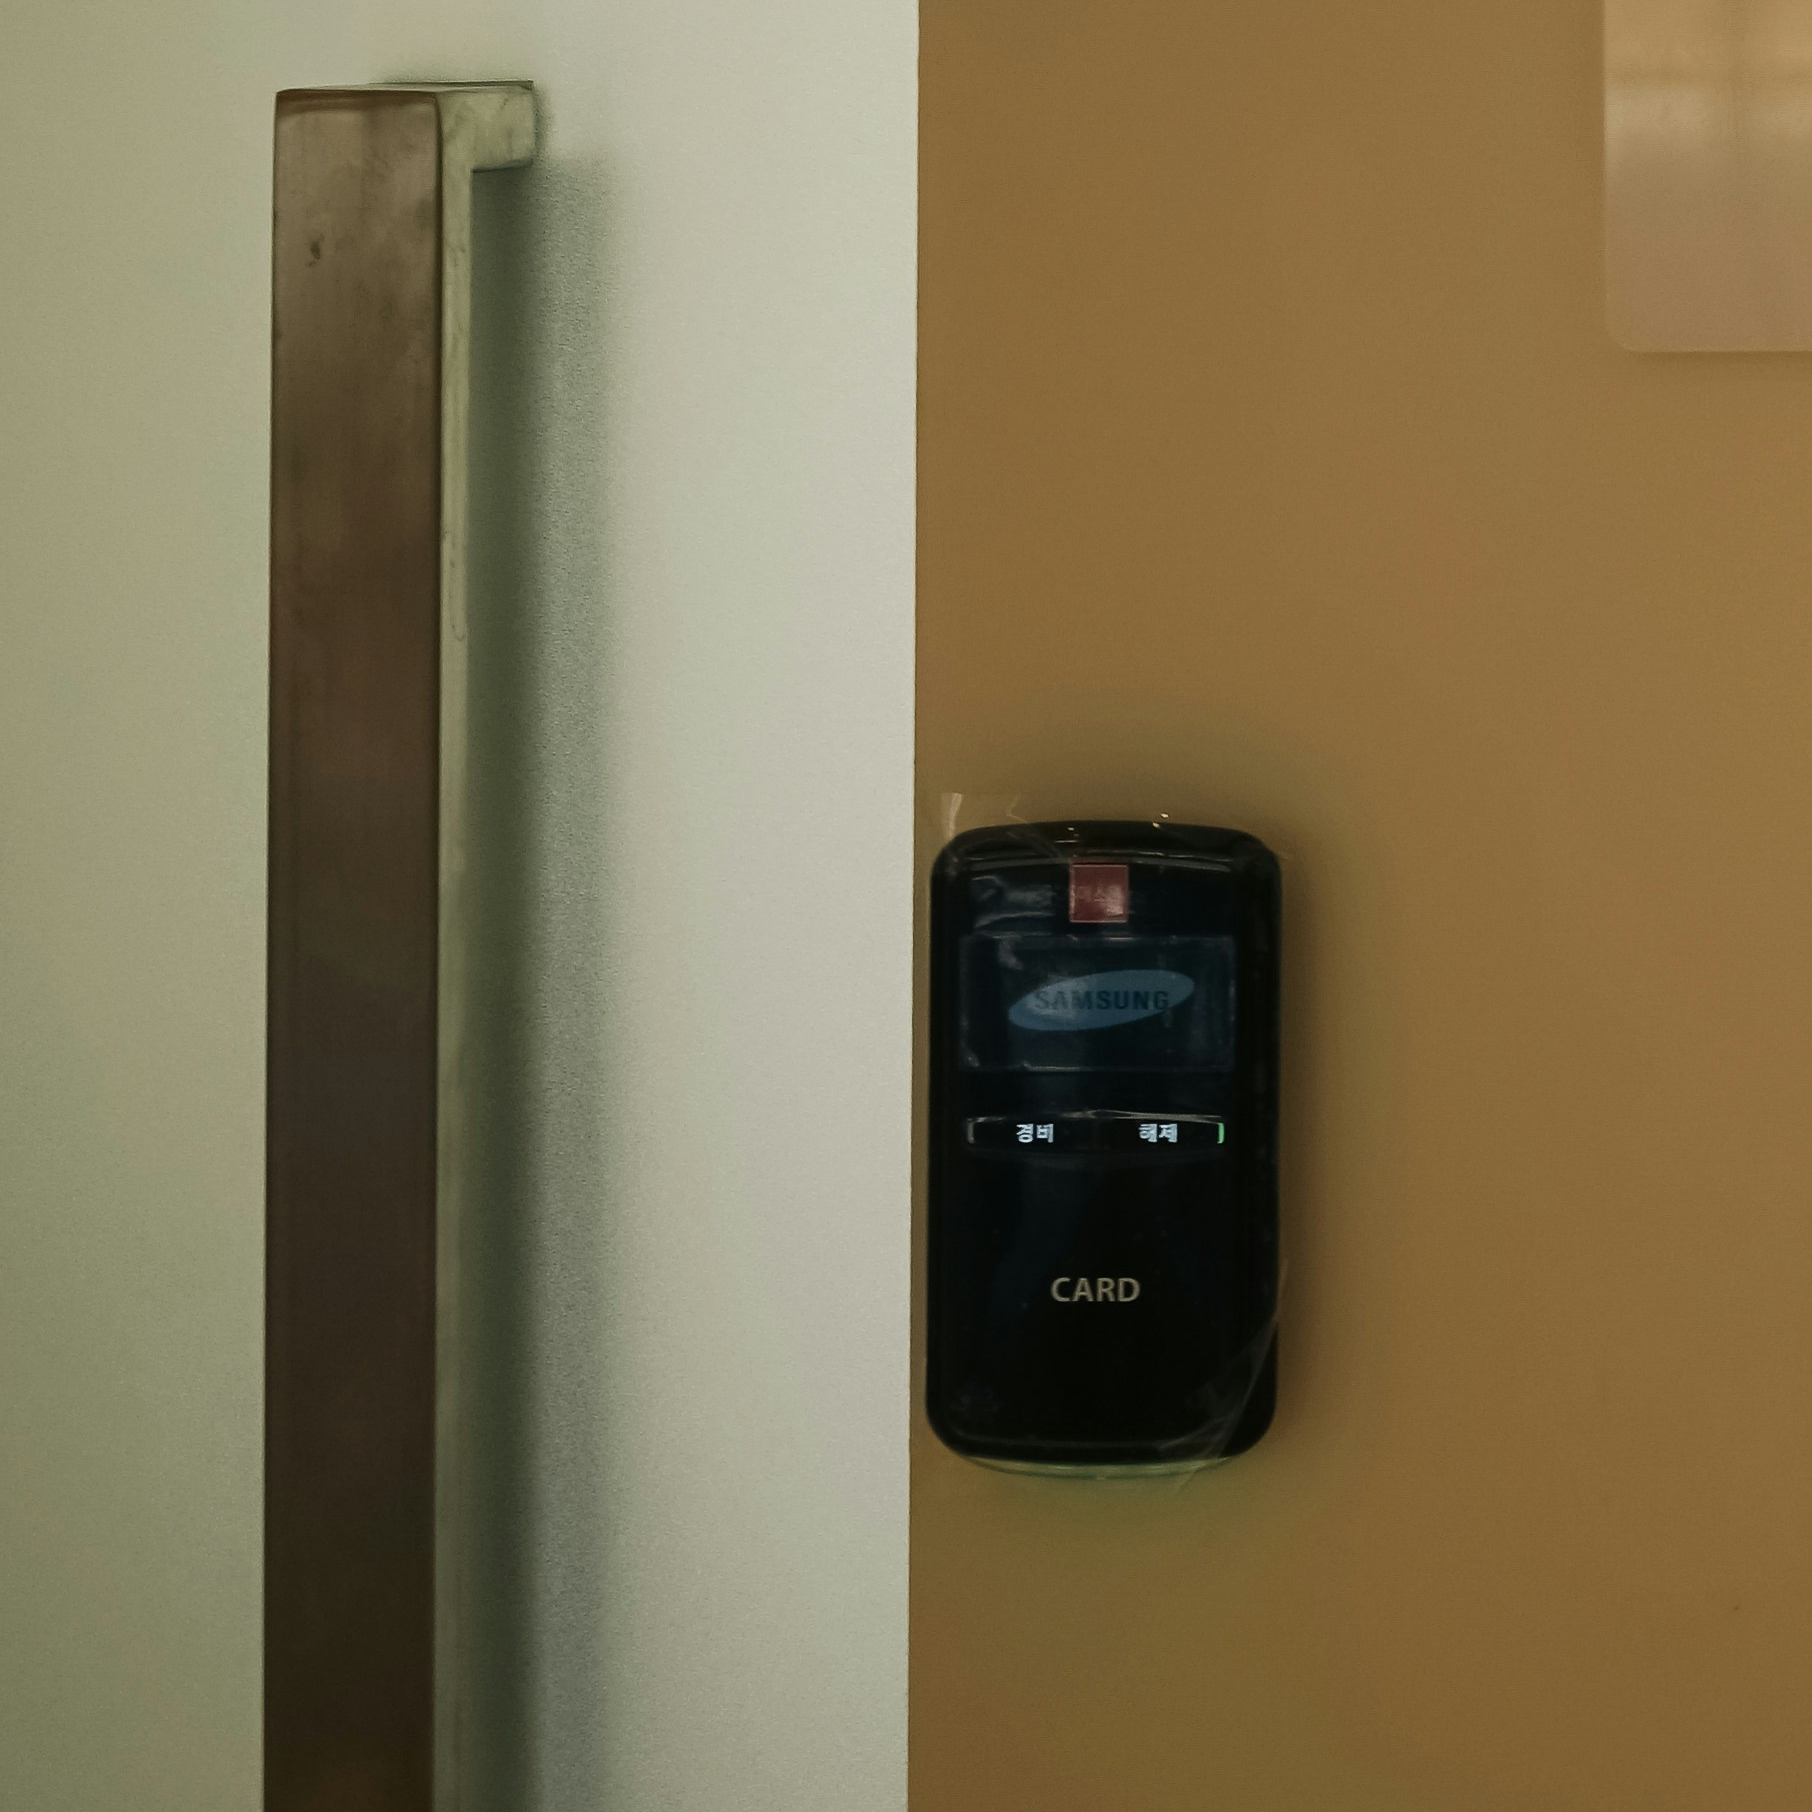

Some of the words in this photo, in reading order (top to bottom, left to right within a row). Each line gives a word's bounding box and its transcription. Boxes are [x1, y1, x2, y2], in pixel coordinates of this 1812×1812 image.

[1035, 989, 1169, 1012] SAMSUNG
[1016, 1123, 1054, 1143] 경비
[1138, 1123, 1178, 1143] 해제
[1050, 1276, 1142, 1303] CARD
